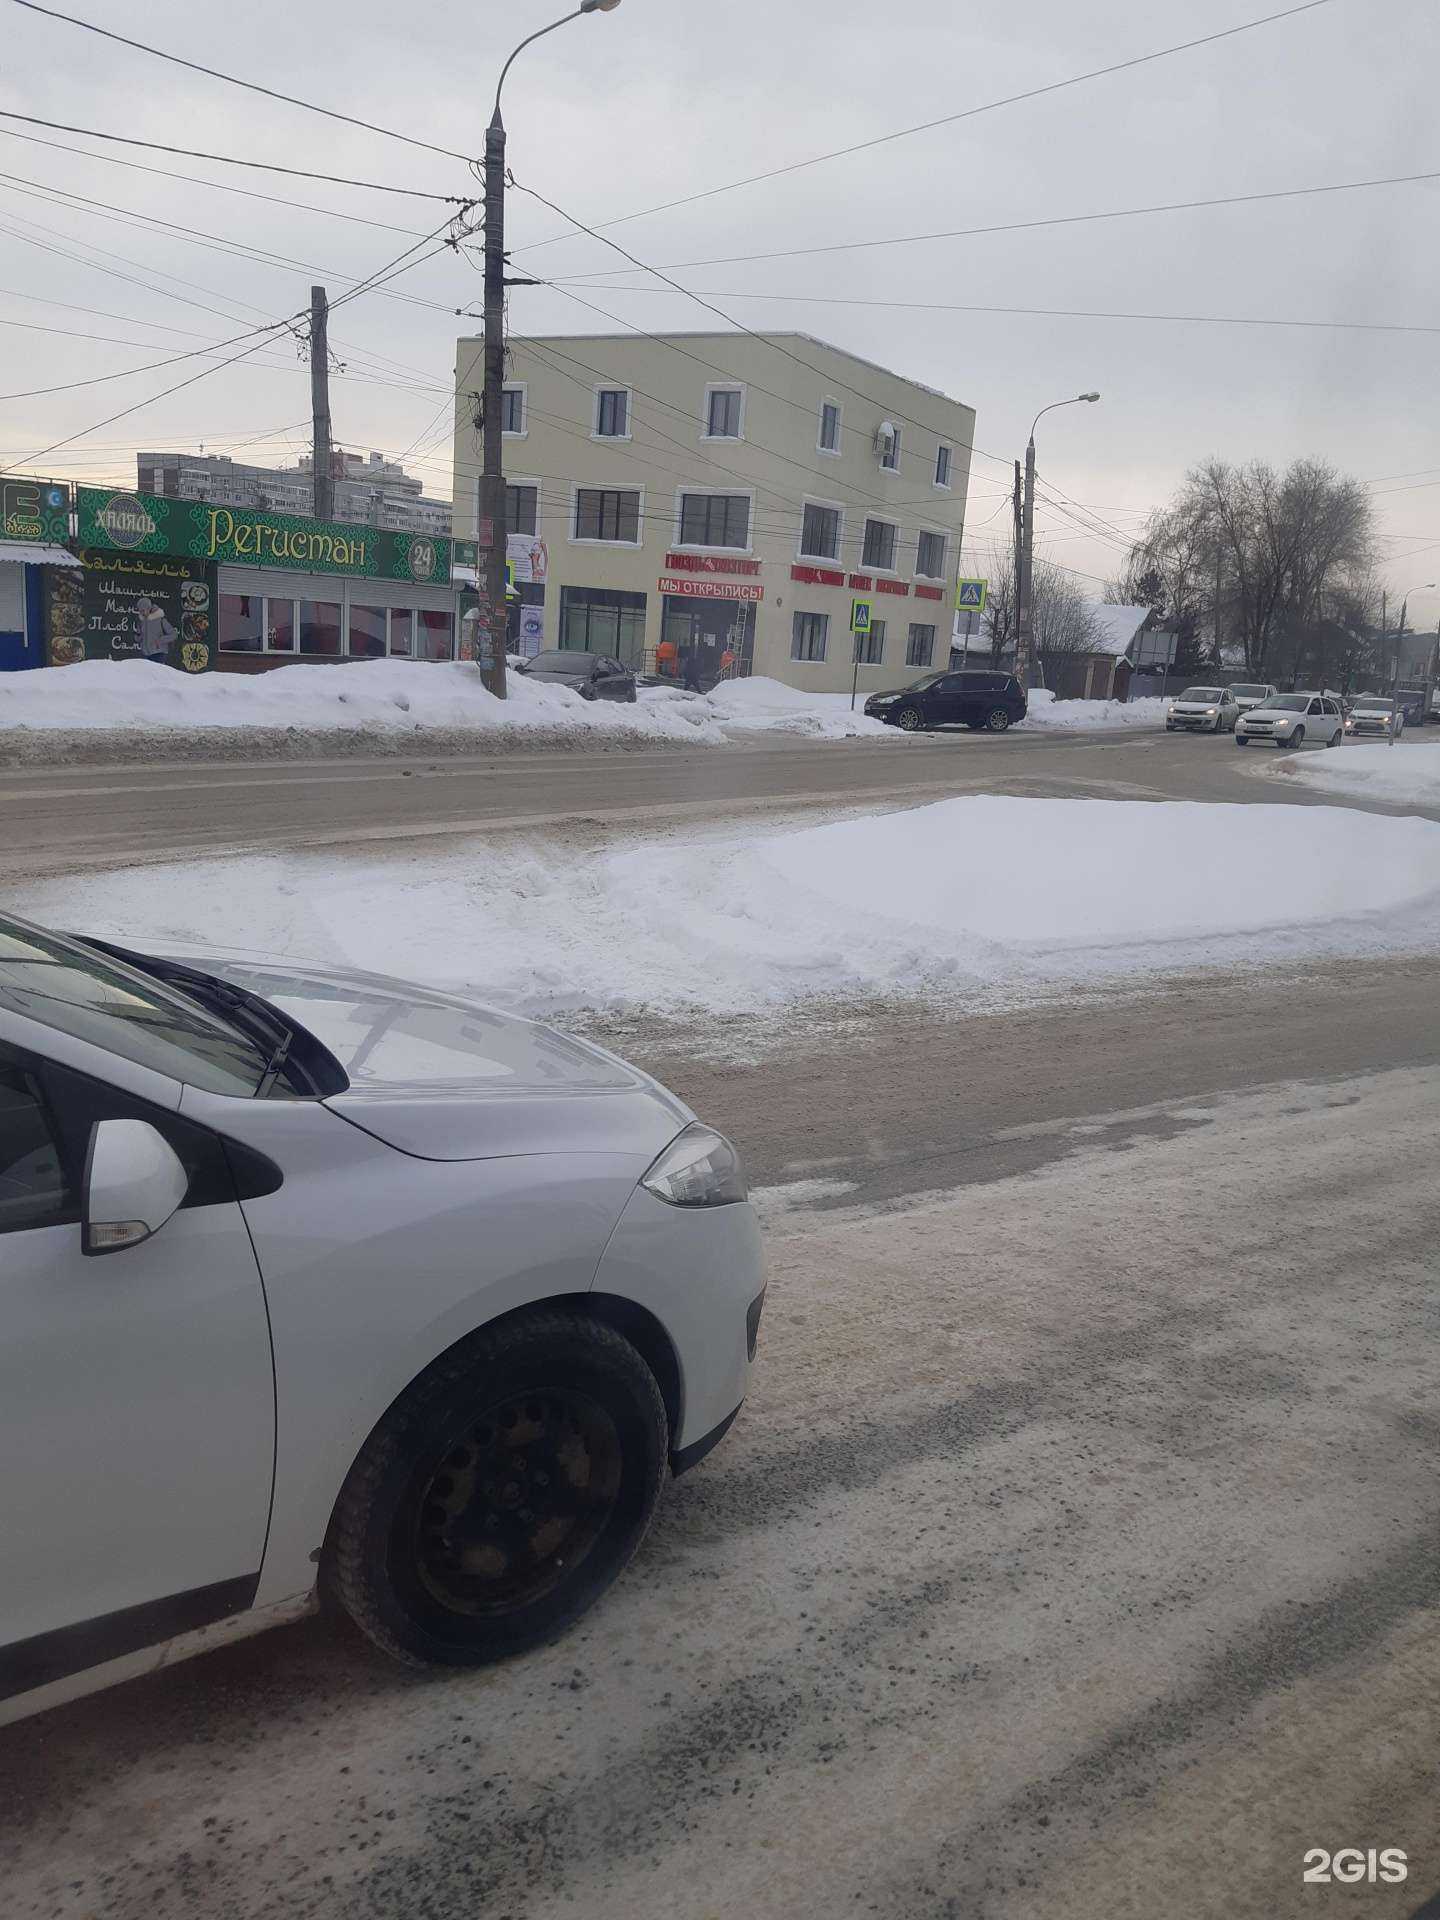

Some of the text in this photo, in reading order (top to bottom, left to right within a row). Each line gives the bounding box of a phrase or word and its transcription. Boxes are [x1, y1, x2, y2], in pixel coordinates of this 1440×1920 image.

[207, 509, 366, 566] Регистан
[414, 545, 431, 566] 24
[660, 579, 762, 599] МЫ ОТКРЫЛИСЬ!
[105, 598, 140, 614] Ман
[88, 616, 128, 631] Плов
